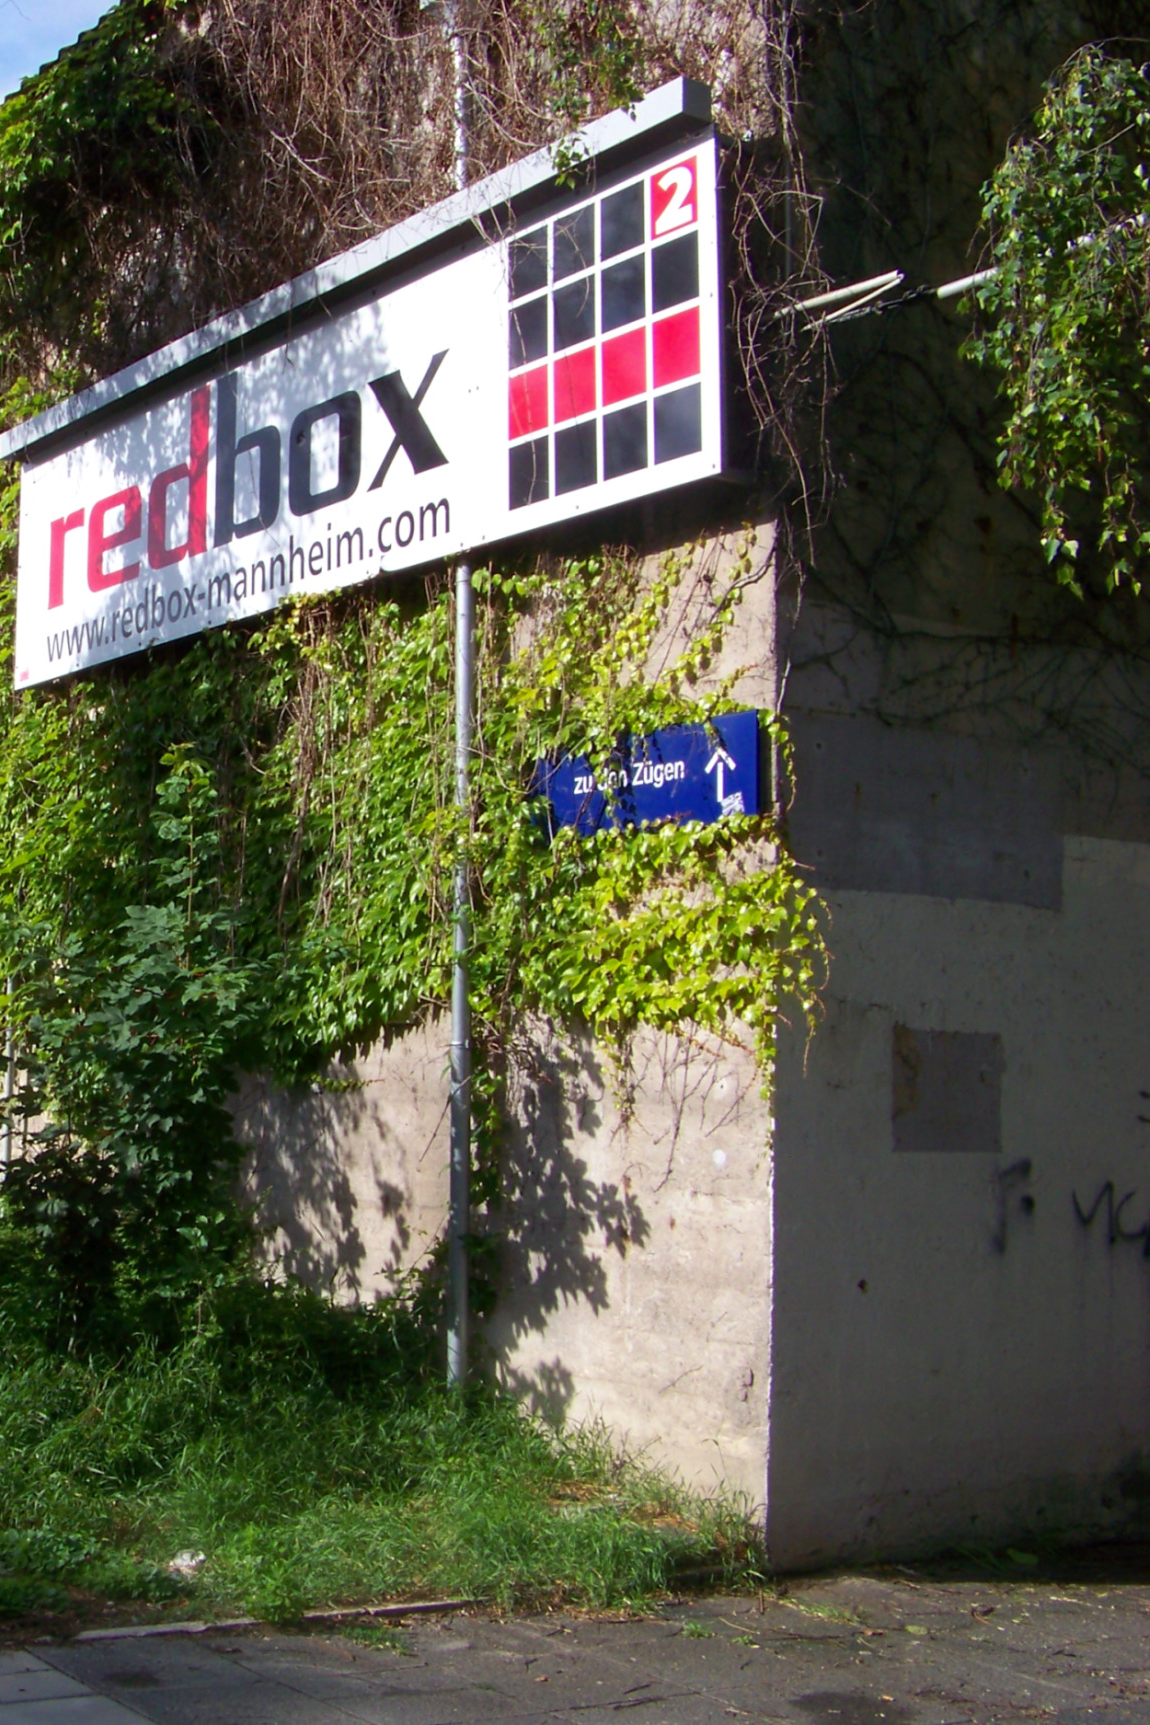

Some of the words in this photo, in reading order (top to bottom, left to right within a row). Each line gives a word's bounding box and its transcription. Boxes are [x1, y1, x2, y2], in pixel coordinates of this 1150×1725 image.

[655, 166, 693, 235] 2
[47, 348, 450, 610] redbox
[47, 497, 451, 662] www.redbox-mannheim.com
[573, 775, 594, 795] zu
[632, 760, 685, 788] Zügen
